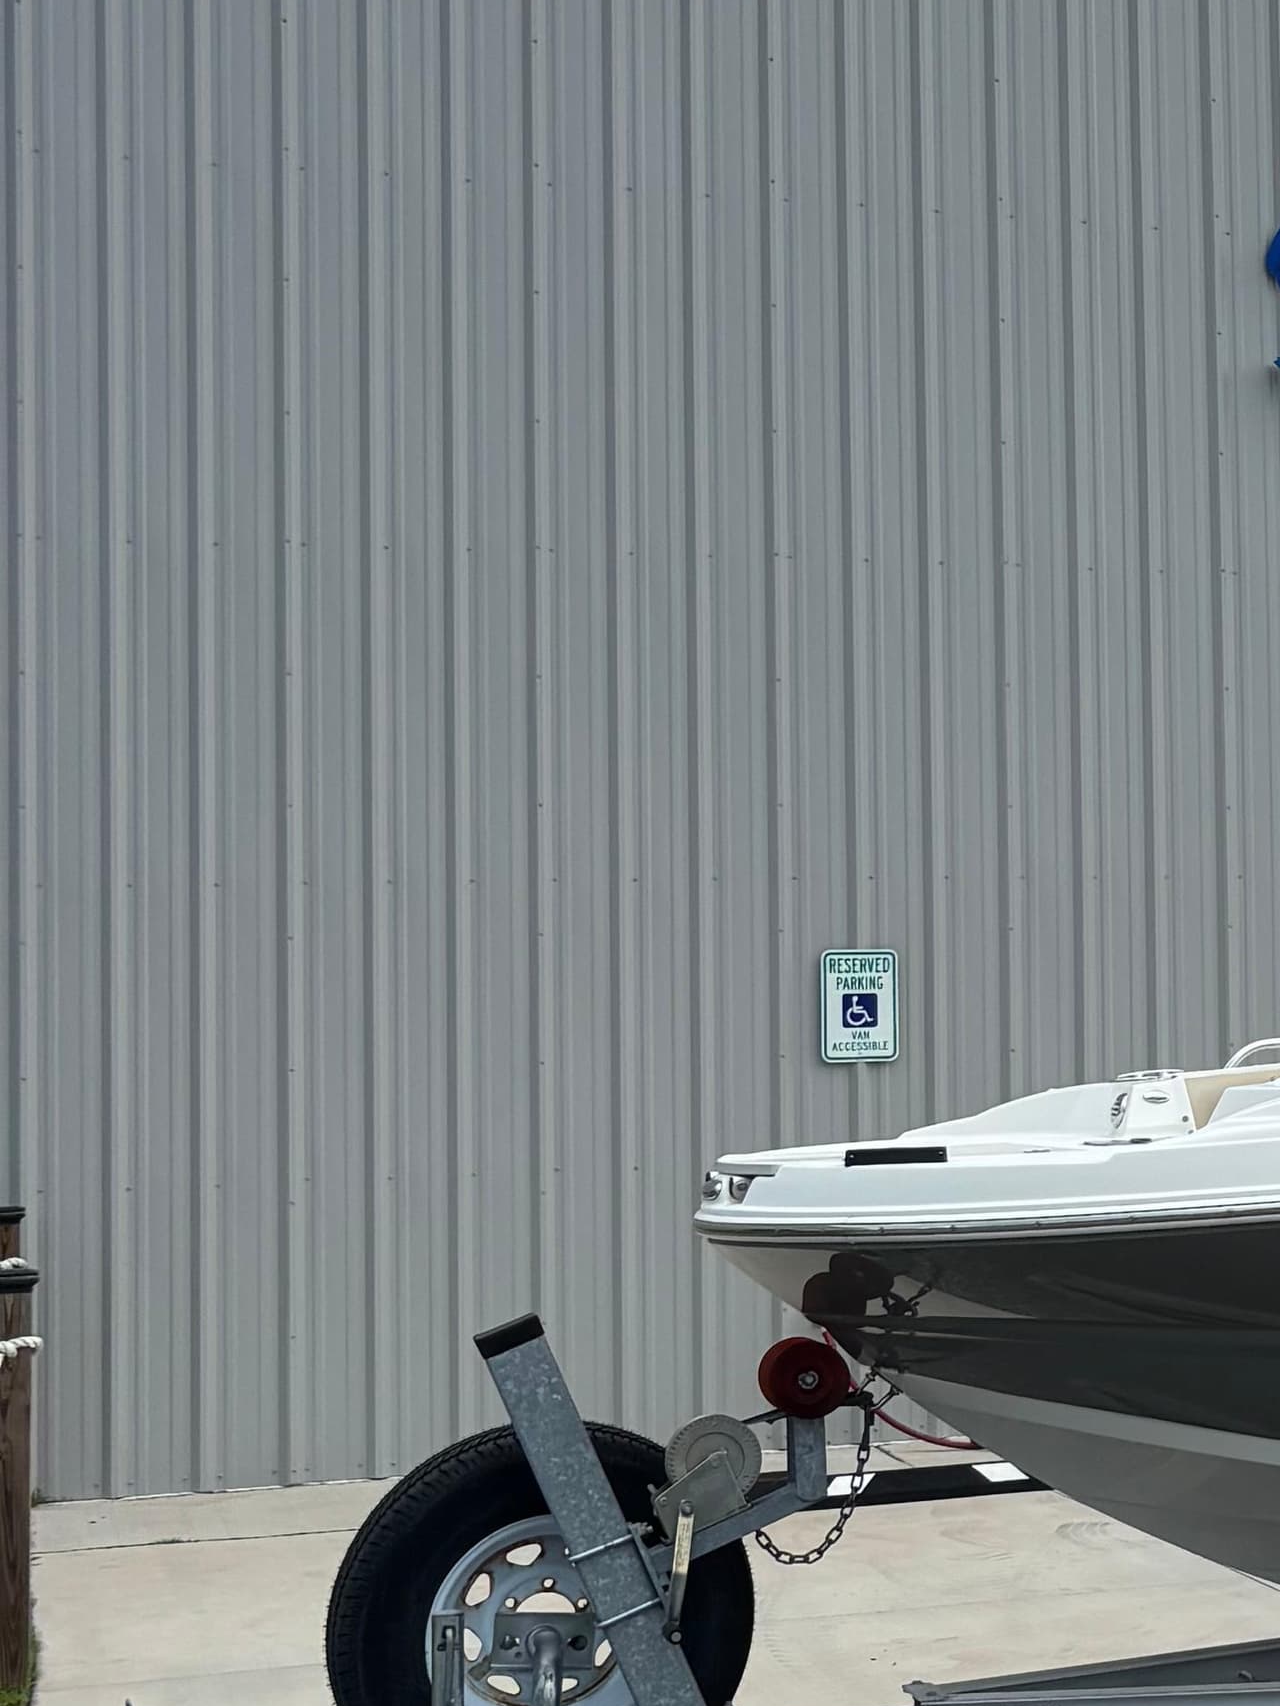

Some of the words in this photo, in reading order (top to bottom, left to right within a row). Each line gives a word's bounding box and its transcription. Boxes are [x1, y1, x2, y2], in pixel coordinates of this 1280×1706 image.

[829, 957, 890, 974] RESERVED
[836, 976, 884, 990] PARKING
[851, 1030, 870, 1040] VAN
[832, 1041, 889, 1051] ACCESSIBLE
